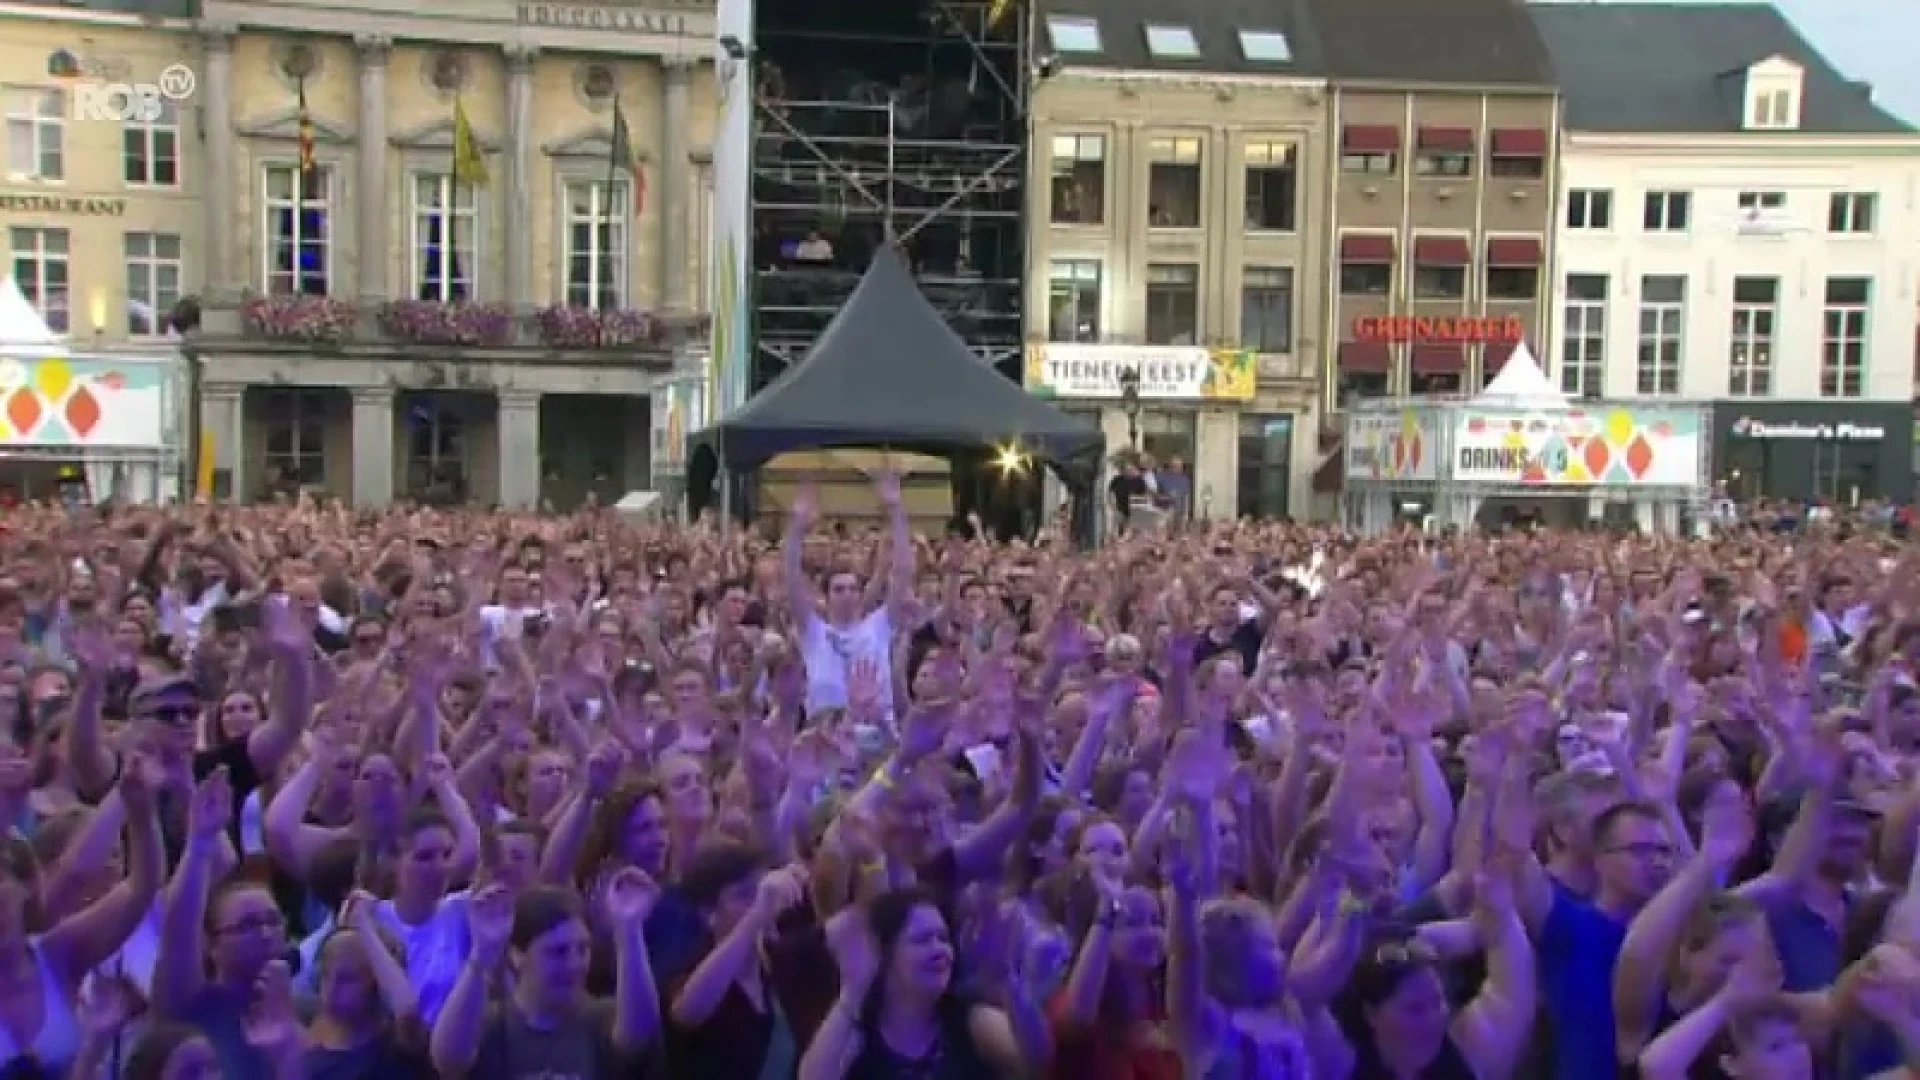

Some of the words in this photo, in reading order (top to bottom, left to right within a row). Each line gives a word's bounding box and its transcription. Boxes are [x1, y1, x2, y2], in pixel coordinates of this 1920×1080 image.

[1353, 316, 1522, 341] GRENADIER
[1751, 419, 1833, 438] Domino's
[1837, 420, 1884, 438] Pizza
[1460, 447, 1528, 470] DRINKS
